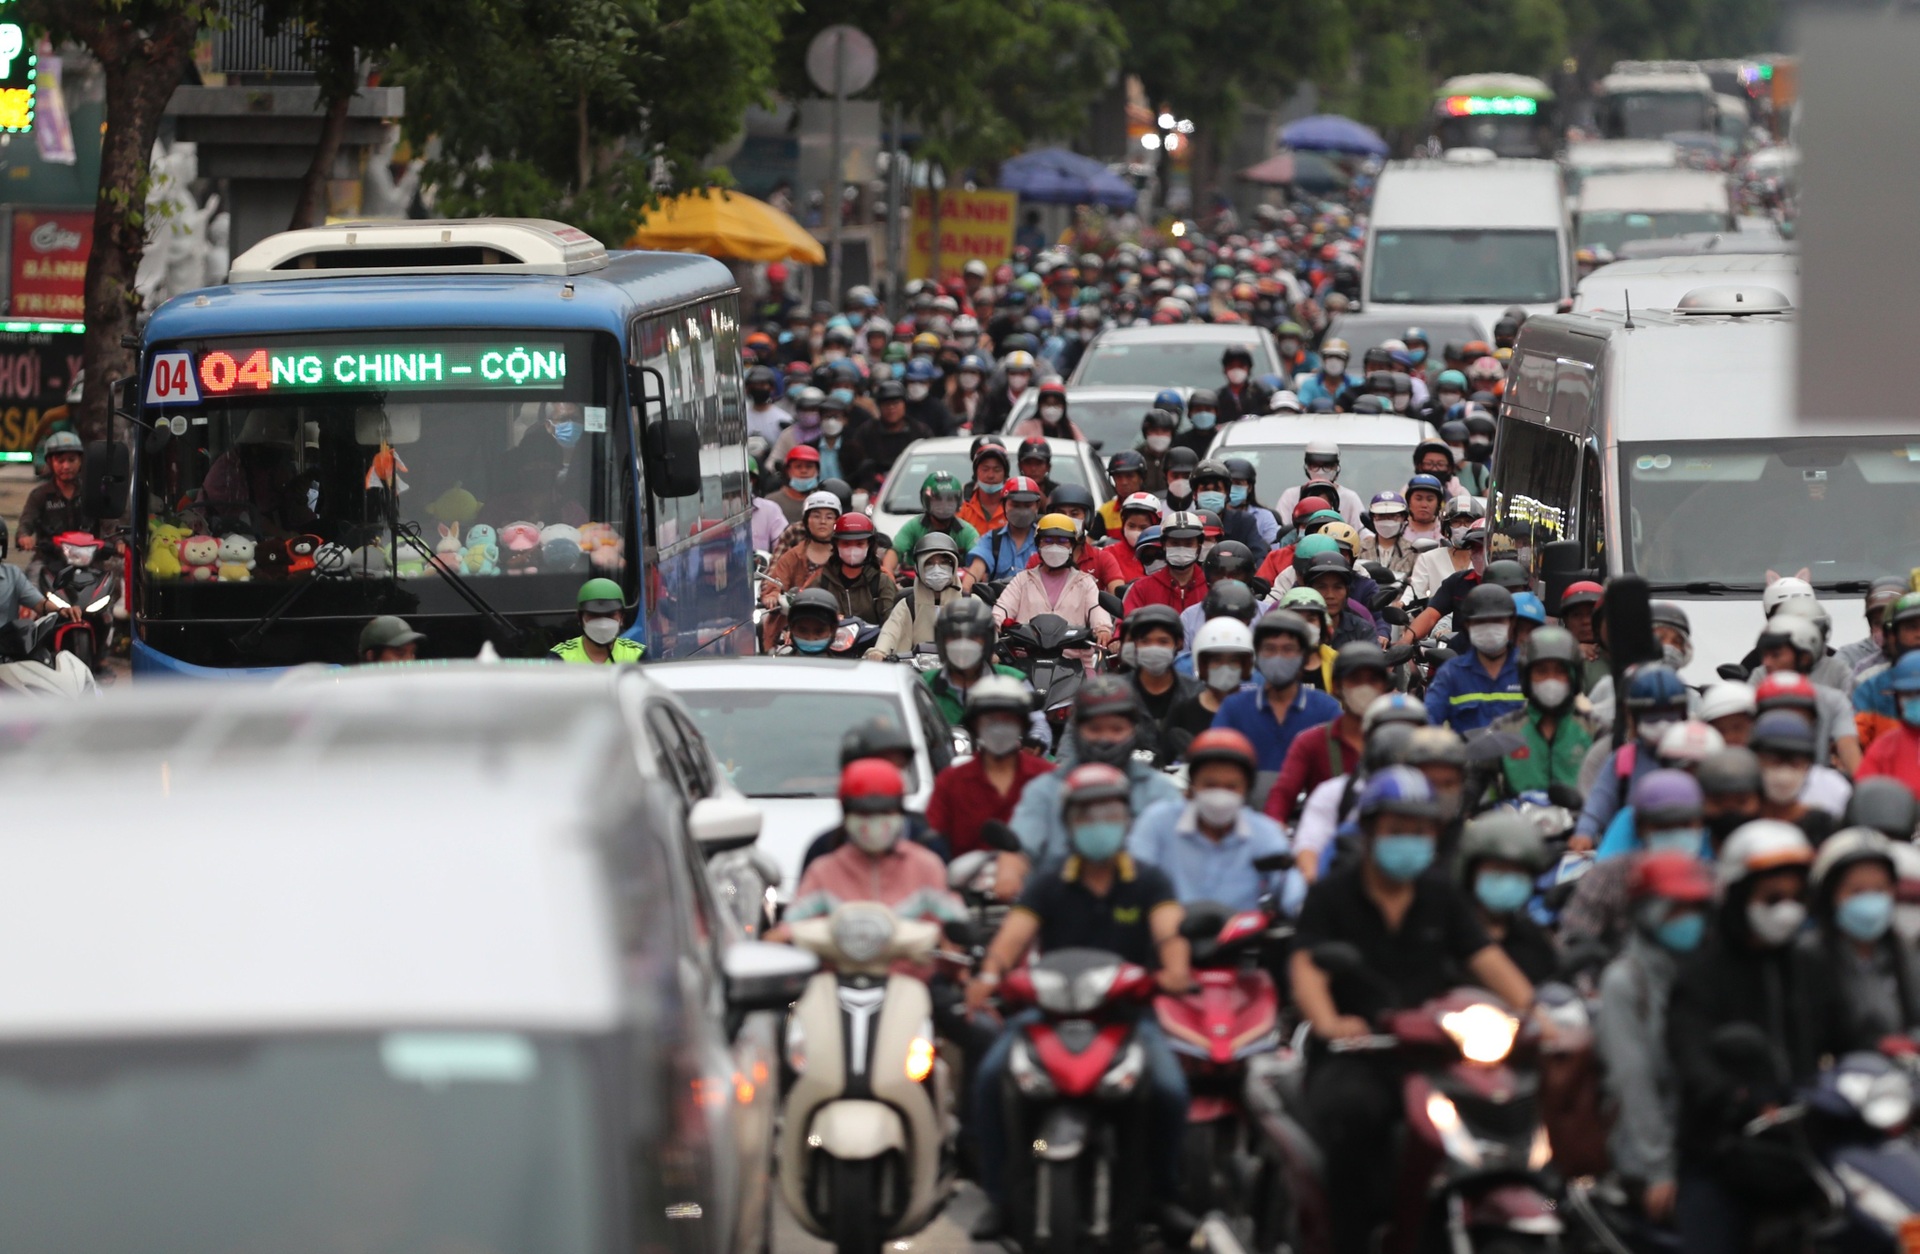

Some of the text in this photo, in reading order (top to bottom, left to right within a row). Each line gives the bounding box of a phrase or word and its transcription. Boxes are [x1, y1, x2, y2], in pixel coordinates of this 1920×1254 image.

[155, 359, 188, 397] 04
[200, 350, 272, 391] 04
[334, 353, 442, 383] CHINH
